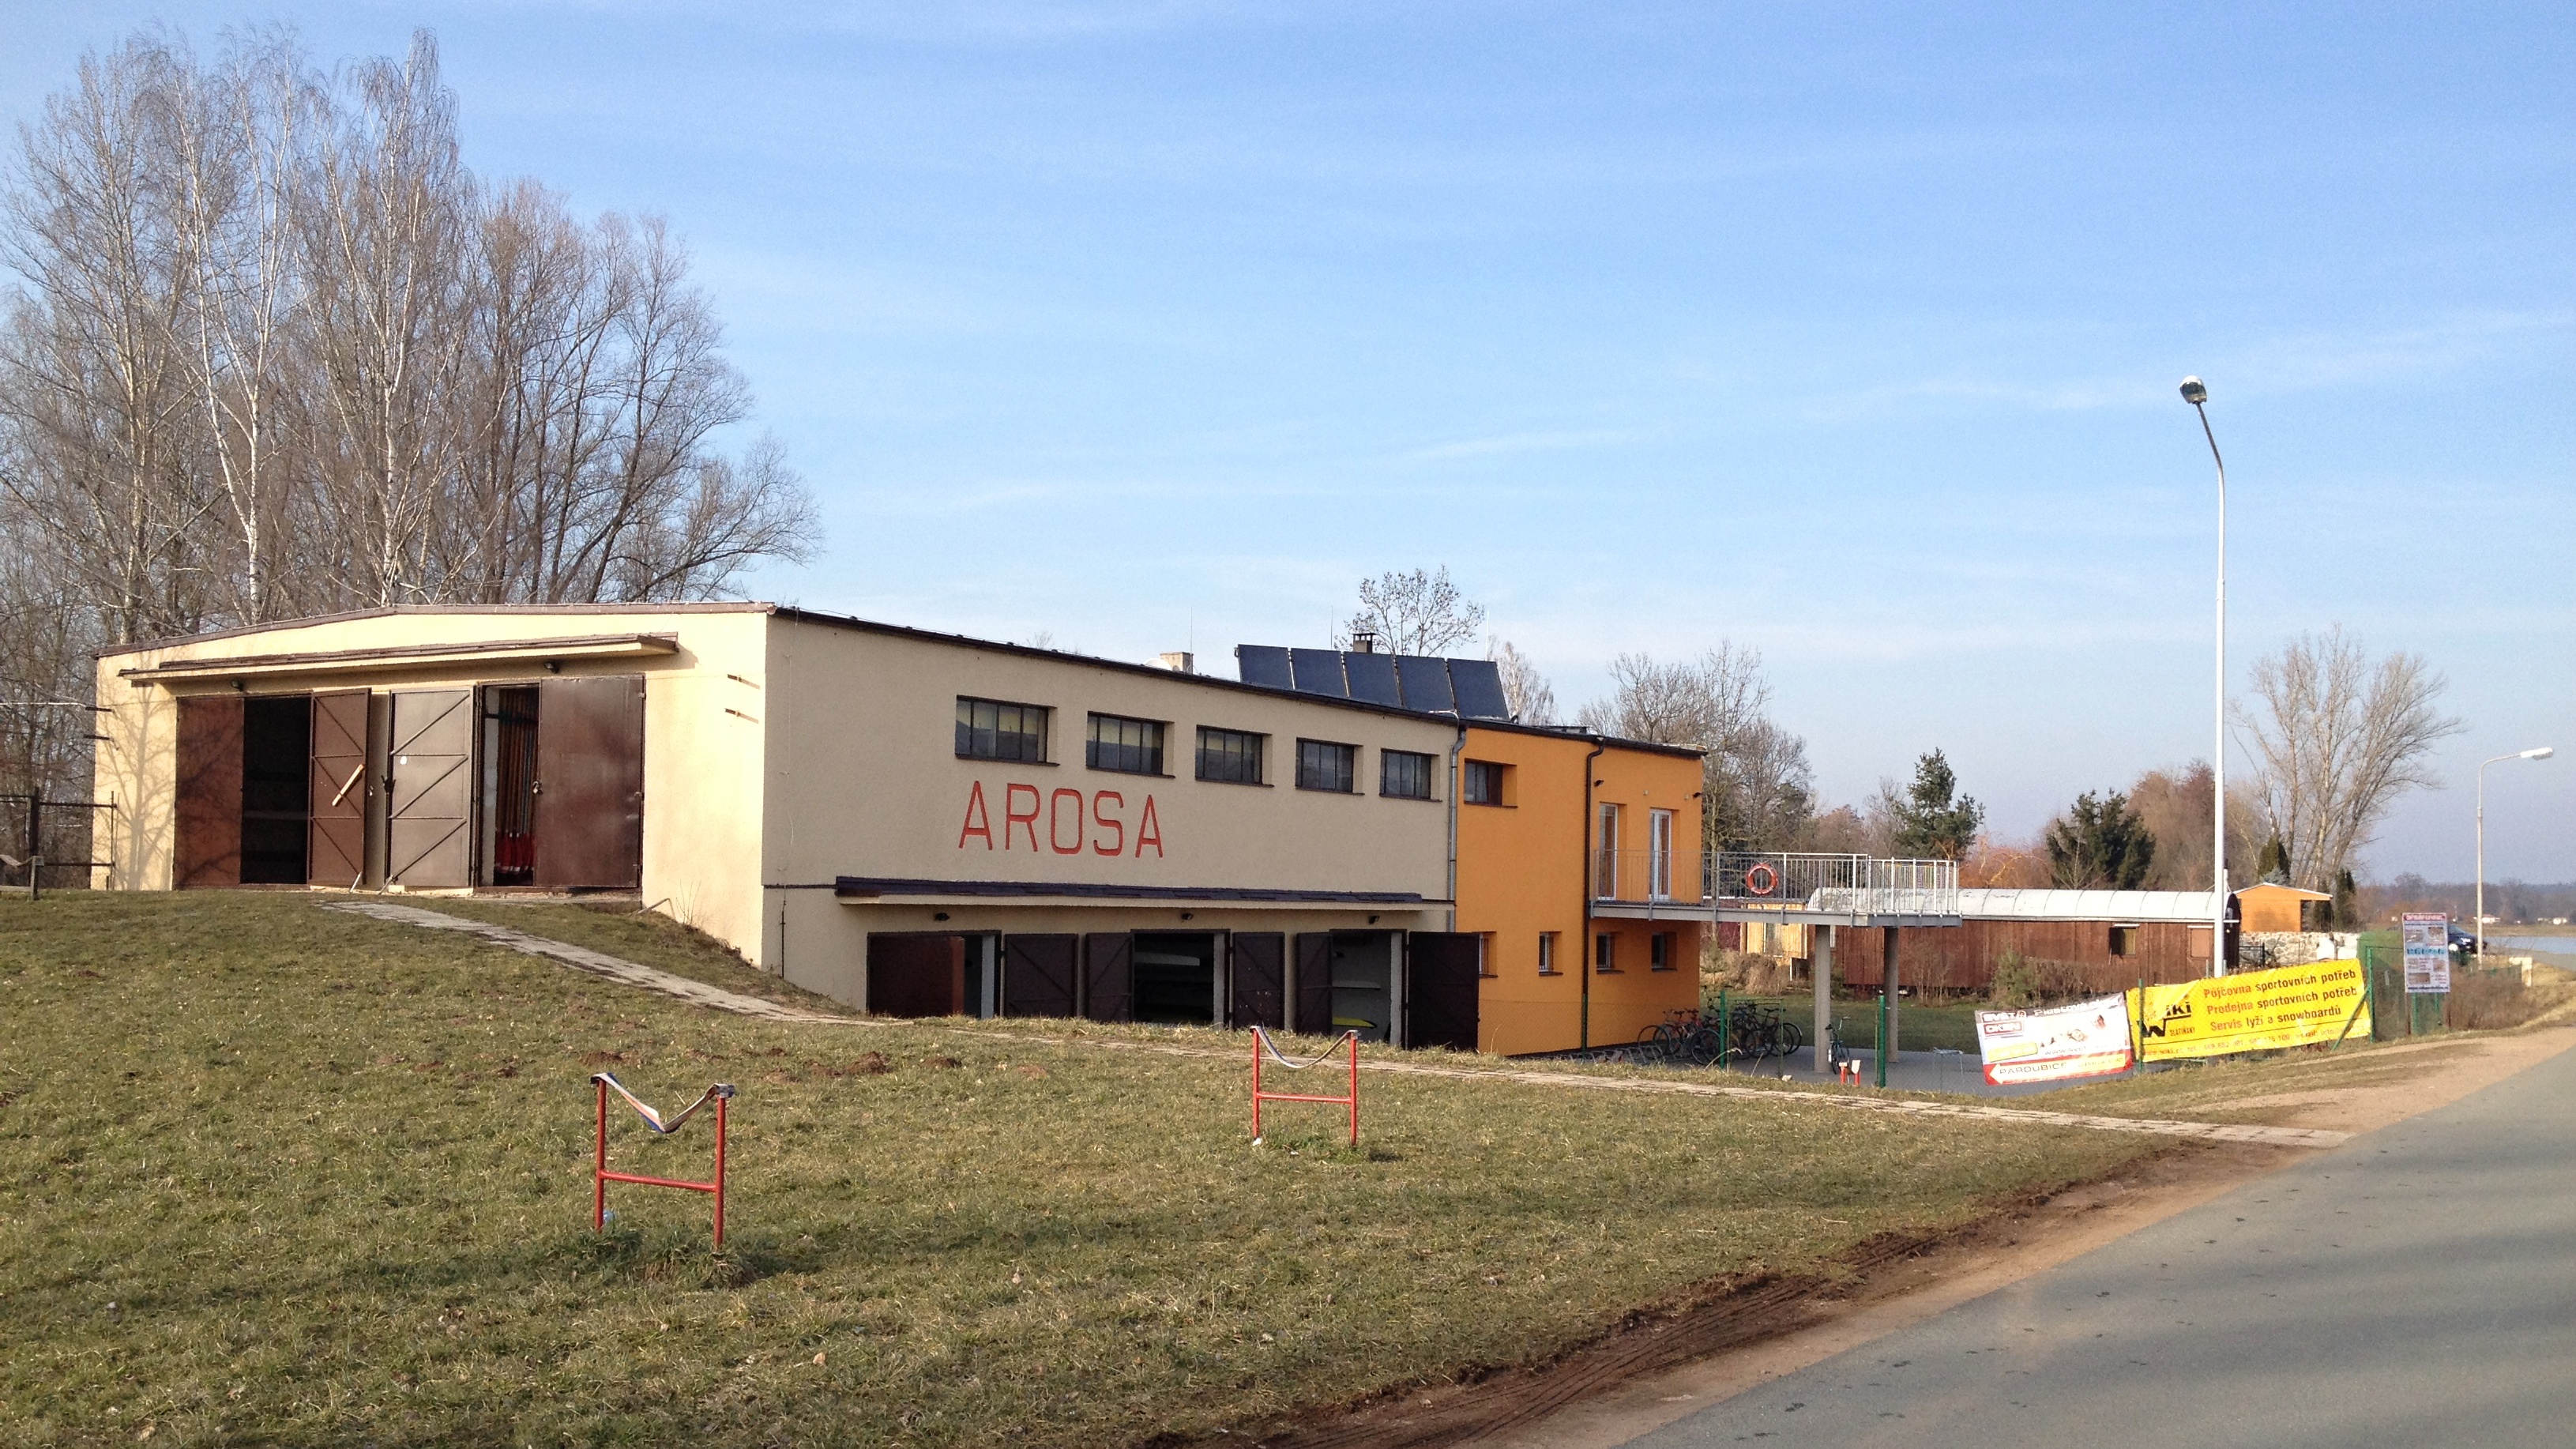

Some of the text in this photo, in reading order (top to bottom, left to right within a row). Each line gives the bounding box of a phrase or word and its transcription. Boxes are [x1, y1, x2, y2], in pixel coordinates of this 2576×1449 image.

[958, 781, 1164, 858] AROSA
[2204, 969, 2356, 999] Půjčovna sportovních potřeb
[2207, 986, 2357, 1014] Prodejna sportovních potřeb
[2210, 1019, 2243, 1031] Servis
[2246, 1015, 2264, 1029] lyží
[2277, 1005, 2341, 1023] snowboardů
